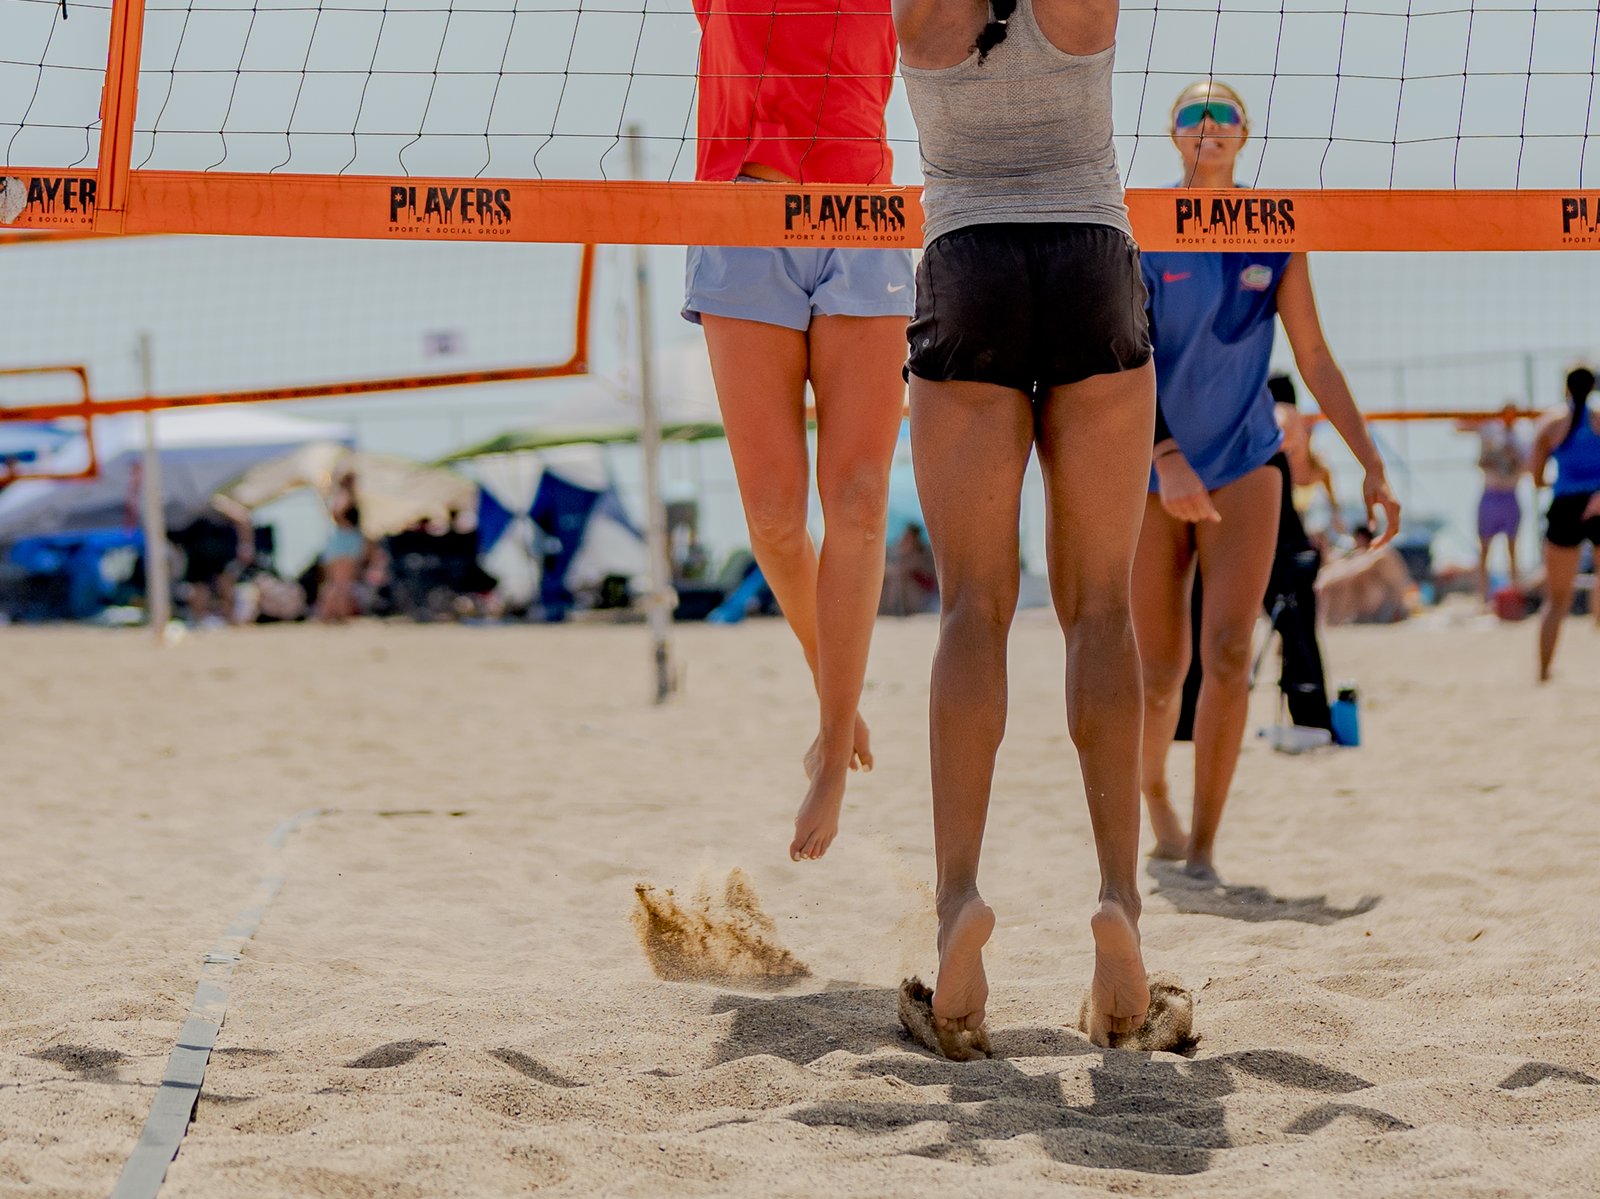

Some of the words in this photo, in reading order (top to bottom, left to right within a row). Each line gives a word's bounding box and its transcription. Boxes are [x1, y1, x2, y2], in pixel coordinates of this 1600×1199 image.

[0, 177, 97, 215] AYER
[390, 186, 511, 225] PLAYERS
[785, 194, 905, 232] PLAYERS
[1176, 198, 1295, 235] PLAYERS
